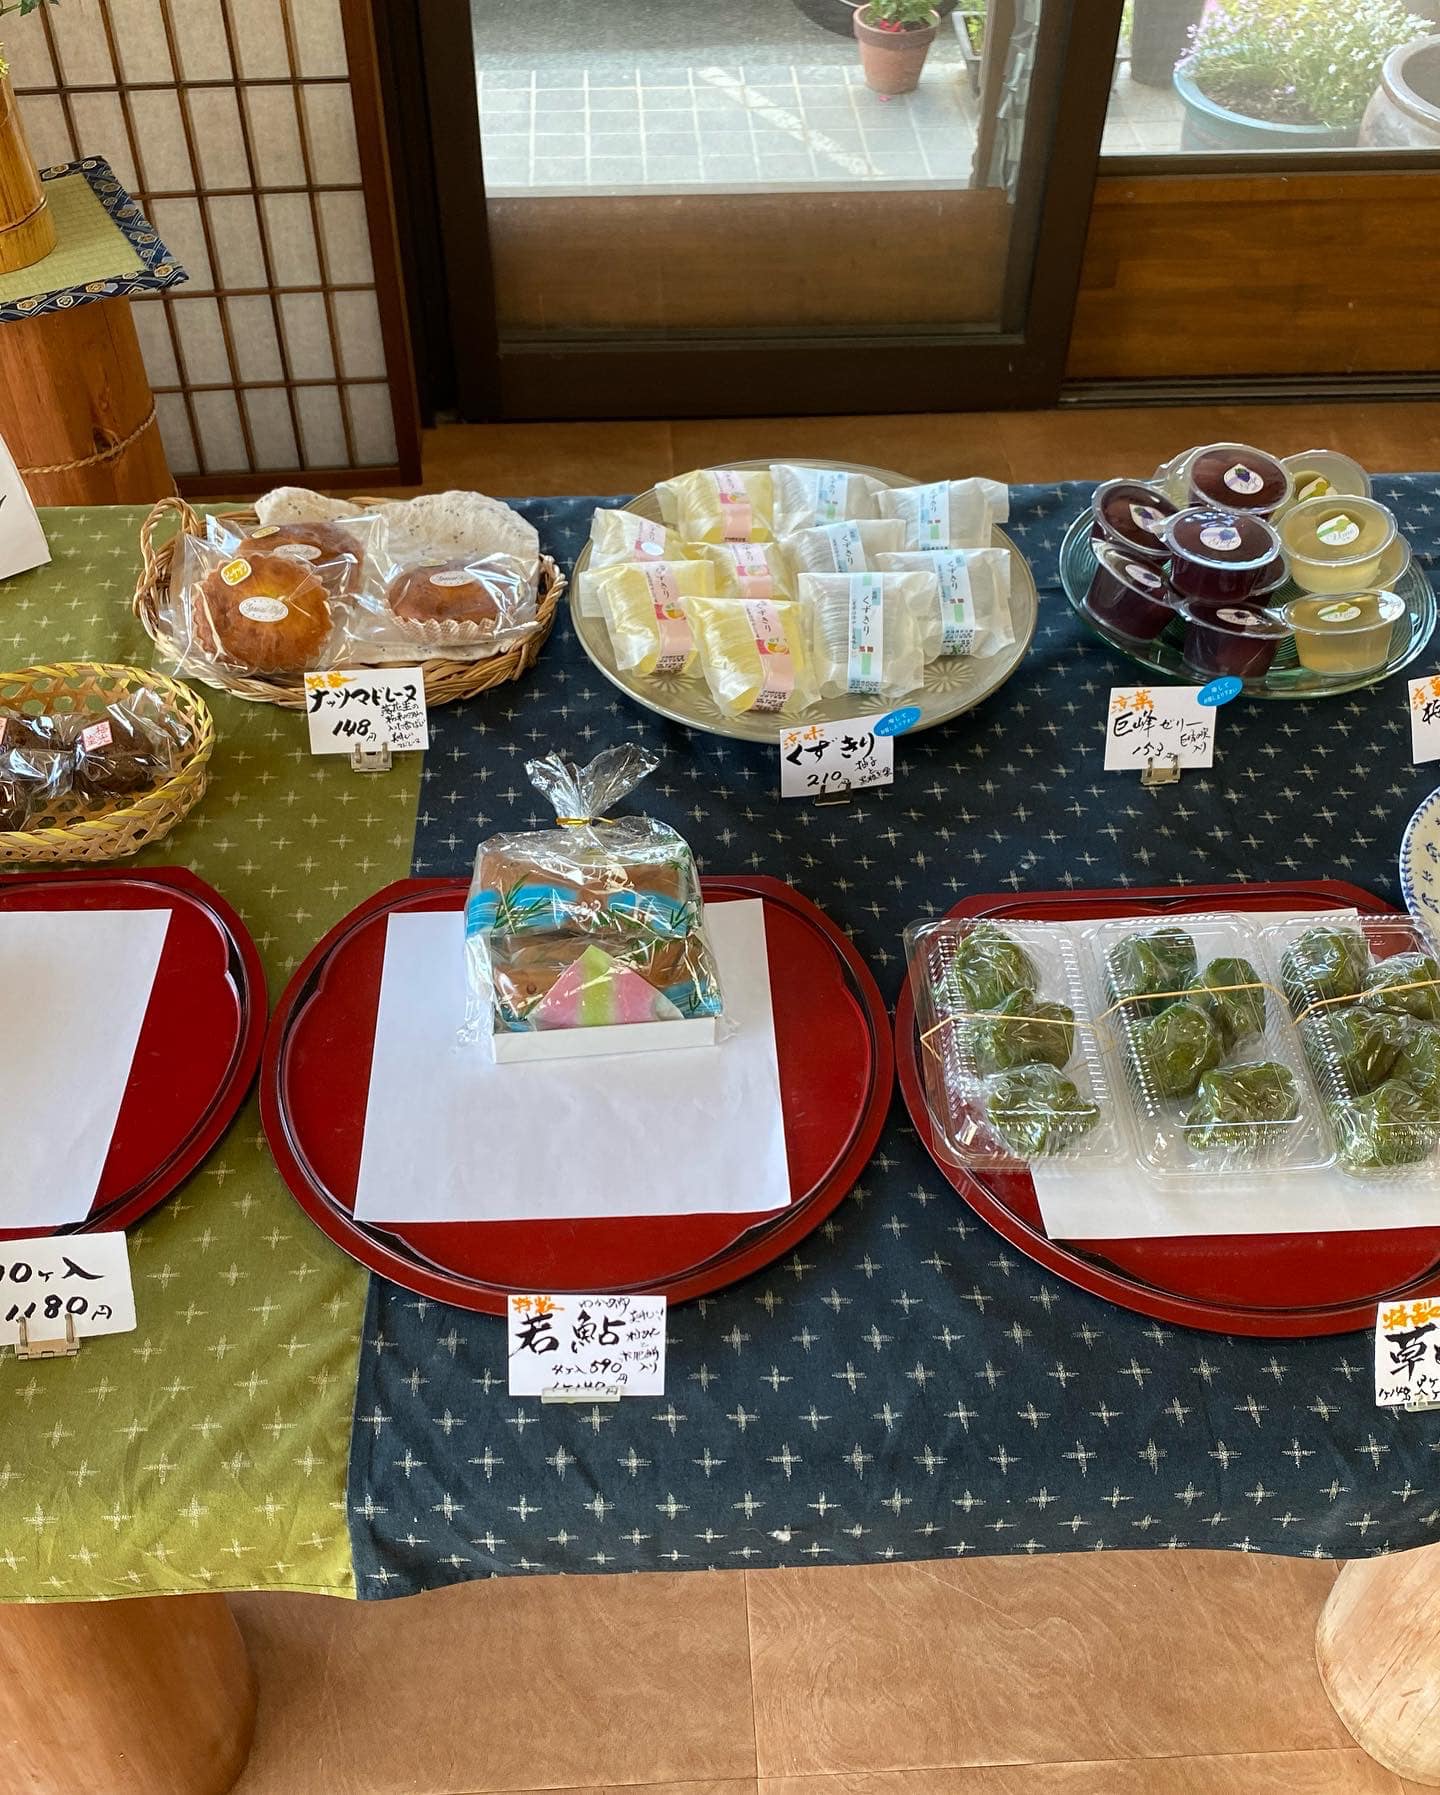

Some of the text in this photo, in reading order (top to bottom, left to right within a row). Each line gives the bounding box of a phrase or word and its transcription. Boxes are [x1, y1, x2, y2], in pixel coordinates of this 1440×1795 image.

[309, 684, 417, 713] ナッツマドレーヌ
[332, 718, 377, 742] 148円
[786, 731, 875, 767] くずきり
[510, 1310, 626, 1358] 若鮎
